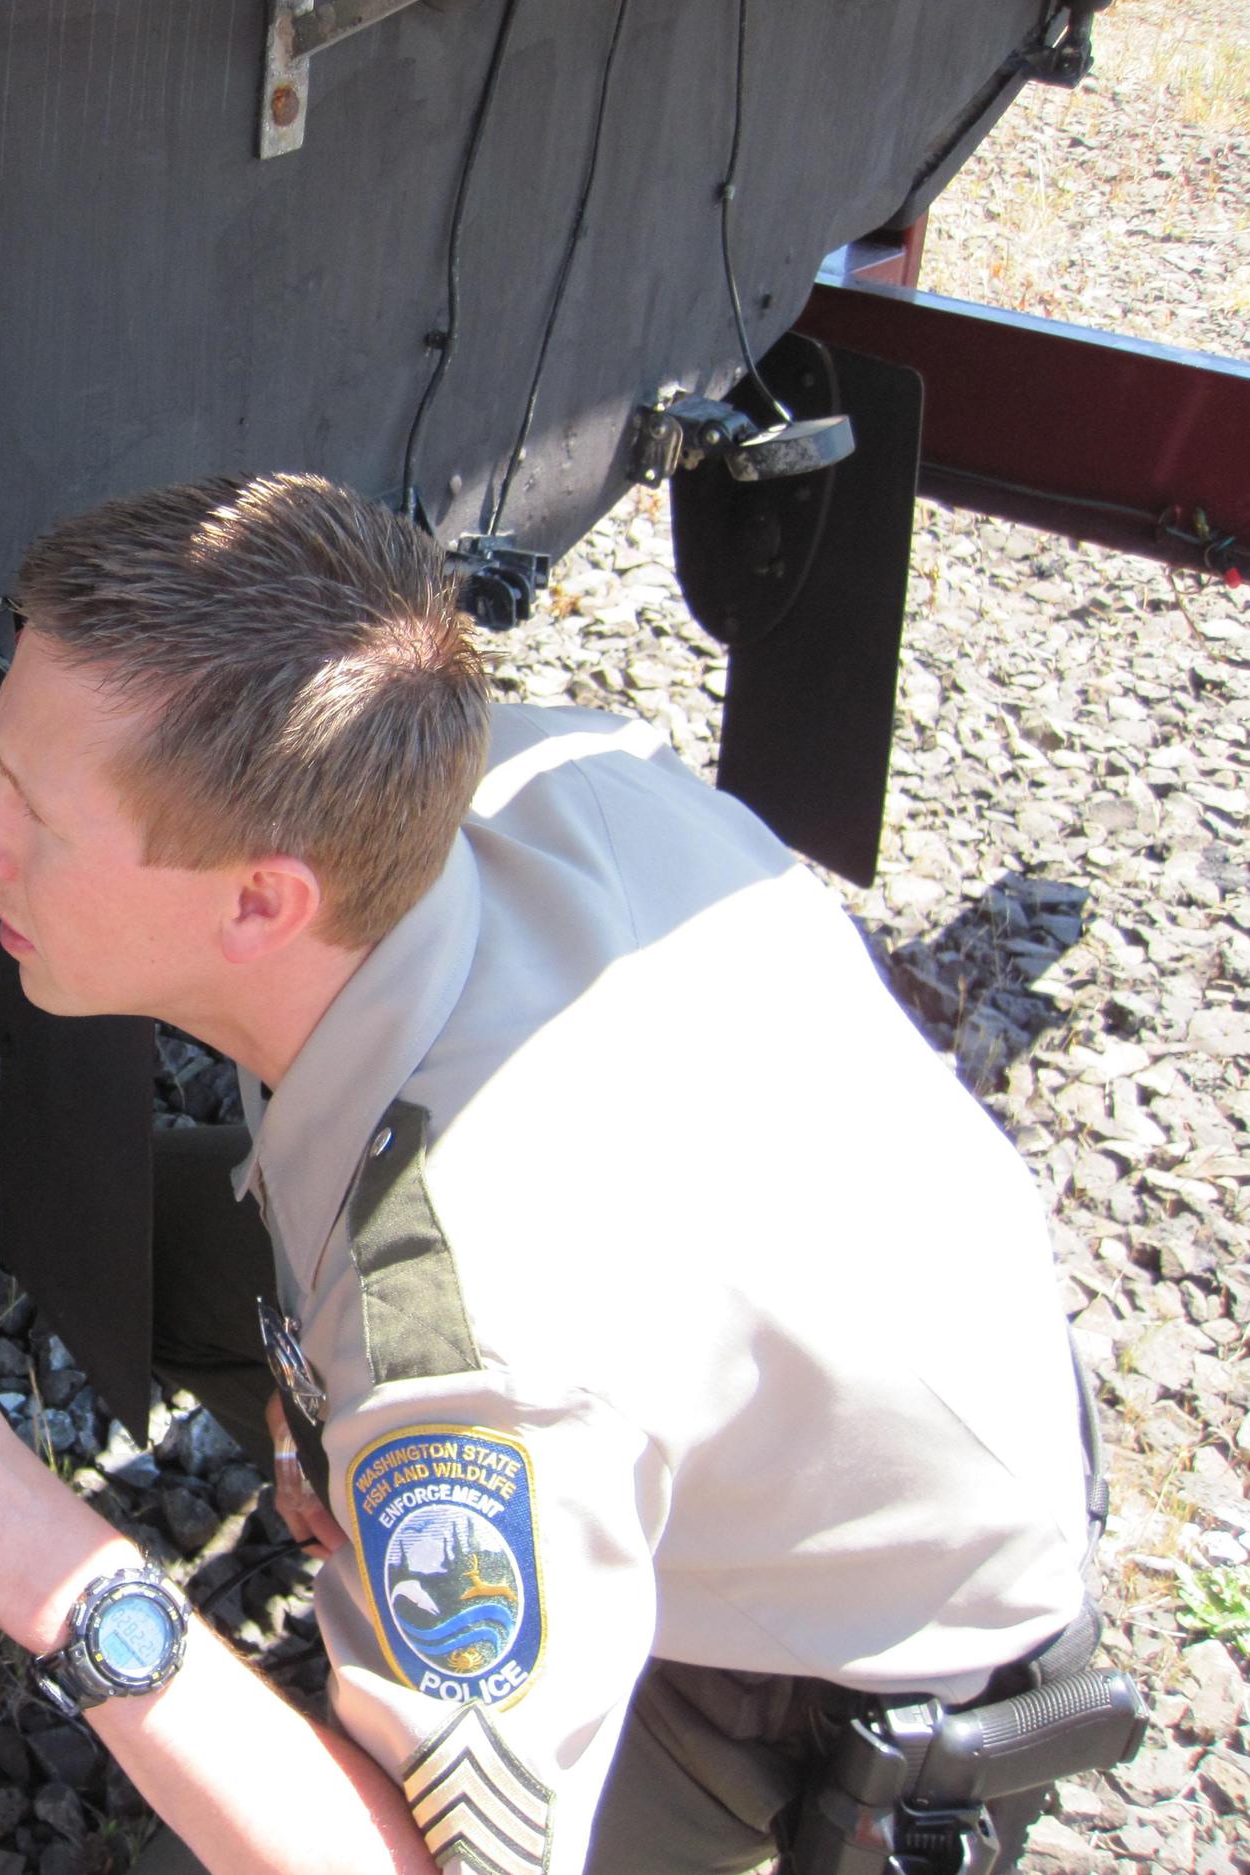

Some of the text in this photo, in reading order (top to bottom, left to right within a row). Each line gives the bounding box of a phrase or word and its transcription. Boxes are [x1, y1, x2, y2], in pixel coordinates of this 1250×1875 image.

[357, 1442, 522, 1493] WASHINGTON STATE
[363, 1462, 517, 1514] FISH AND WILDLIFE
[379, 1484, 506, 1529] ENFORCEMENT
[420, 1660, 529, 1704] POLICE
